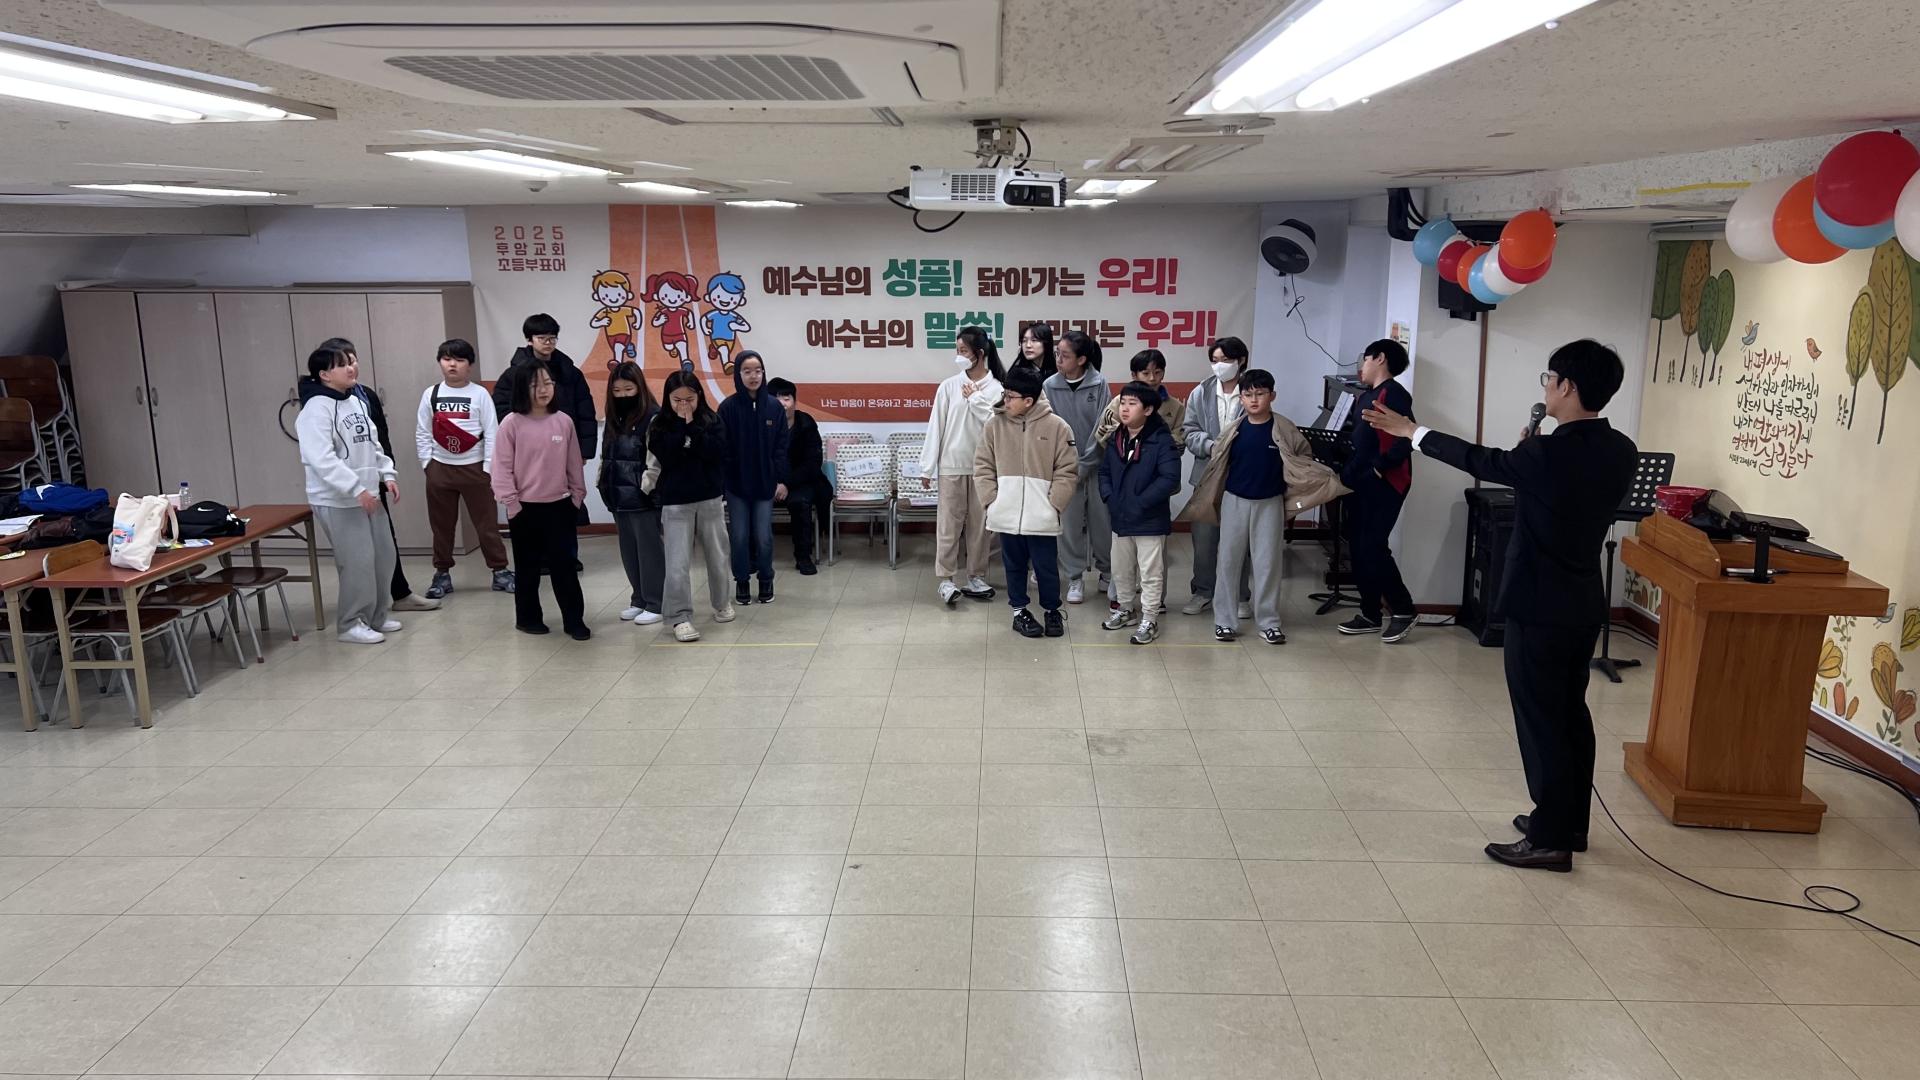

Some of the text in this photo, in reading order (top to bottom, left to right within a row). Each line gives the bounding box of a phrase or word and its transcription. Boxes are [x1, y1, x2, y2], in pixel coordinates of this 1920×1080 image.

[494, 226, 563, 240] 2025
[496, 242, 564, 256] 후암교회
[498, 258, 566, 272] 초등부표어
[763, 257, 1179, 297] 예수님의 성품! 닮아가는 우리!
[806, 318, 913, 348] 예수님의
[1018, 319, 1125, 348] 가는
[1137, 310, 1218, 348] 우리!
[1736, 372, 1819, 399] 선하심과 인자하심이
[821, 398, 838, 408] 나는
[840, 399, 865, 408] 마음이
[868, 399, 901, 408] 온유하고
[1763, 398, 1783, 420] 나를
[1753, 442, 1813, 478] 살리로다
